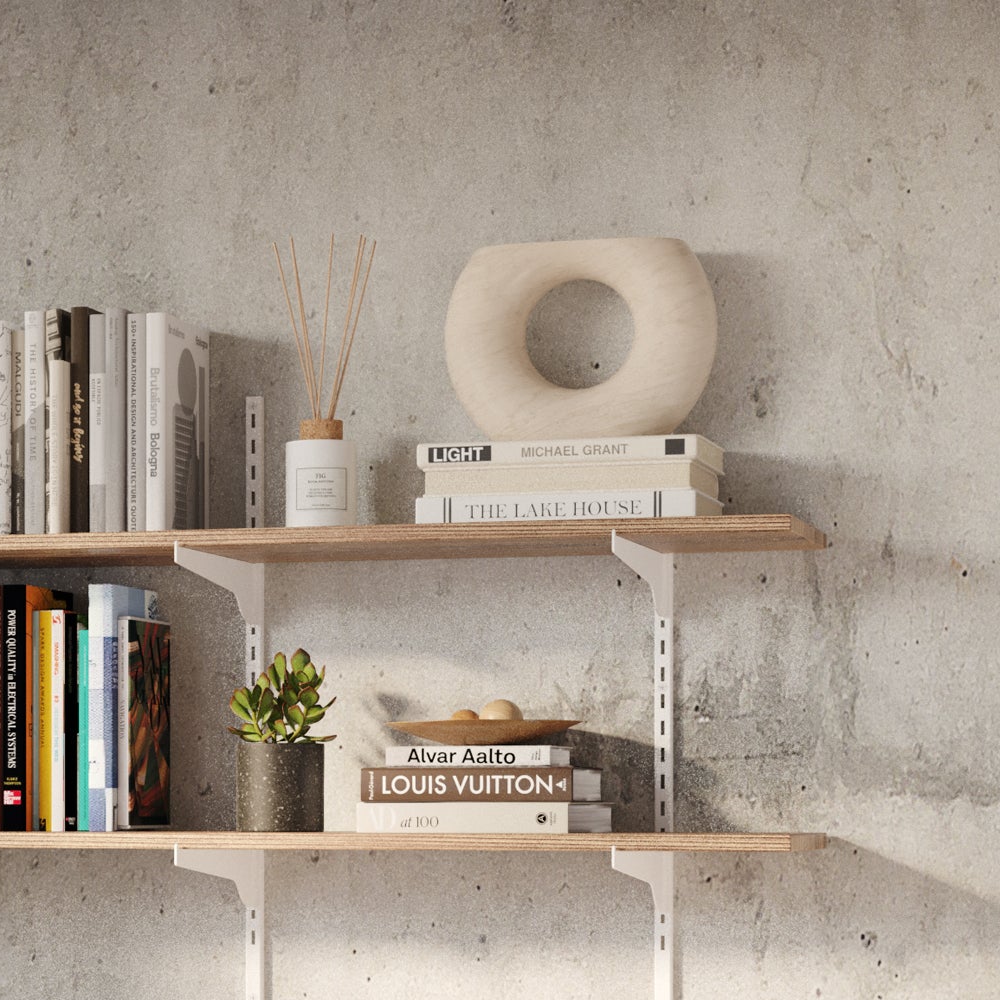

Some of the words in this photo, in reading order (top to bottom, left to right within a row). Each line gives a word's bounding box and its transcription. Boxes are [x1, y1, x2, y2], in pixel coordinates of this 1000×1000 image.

[29, 343, 37, 362] THE
[29, 368, 37, 414] HISTORY
[74, 383, 85, 402] and
[149, 367, 160, 426] Brutalismo
[29, 418, 37, 432] OF
[29, 437, 37, 461] TIME
[71, 428, 85, 463] begins
[148, 432, 160, 478] Bologna
[433, 446, 484, 462] LIGHT
[521, 445, 579, 457] MICHAEL
[582, 443, 629, 456] GRANT
[465, 503, 508, 519] THE
[514, 502, 567, 518] LAKE
[573, 500, 642, 516] HOUSE
[7, 609, 17, 636] POWER
[7, 637, 17, 673] QUALITY
[7, 681, 17, 731] ELECTRICAL
[7, 732, 17, 769] SYSTEMS
[407, 748, 457, 763] Alvar
[462, 748, 516, 764] Aalto
[382, 775, 447, 795] LOUIS
[452, 774, 553, 795] VUITTON
[400, 816, 412, 828] at
[416, 816, 439, 828] 100
